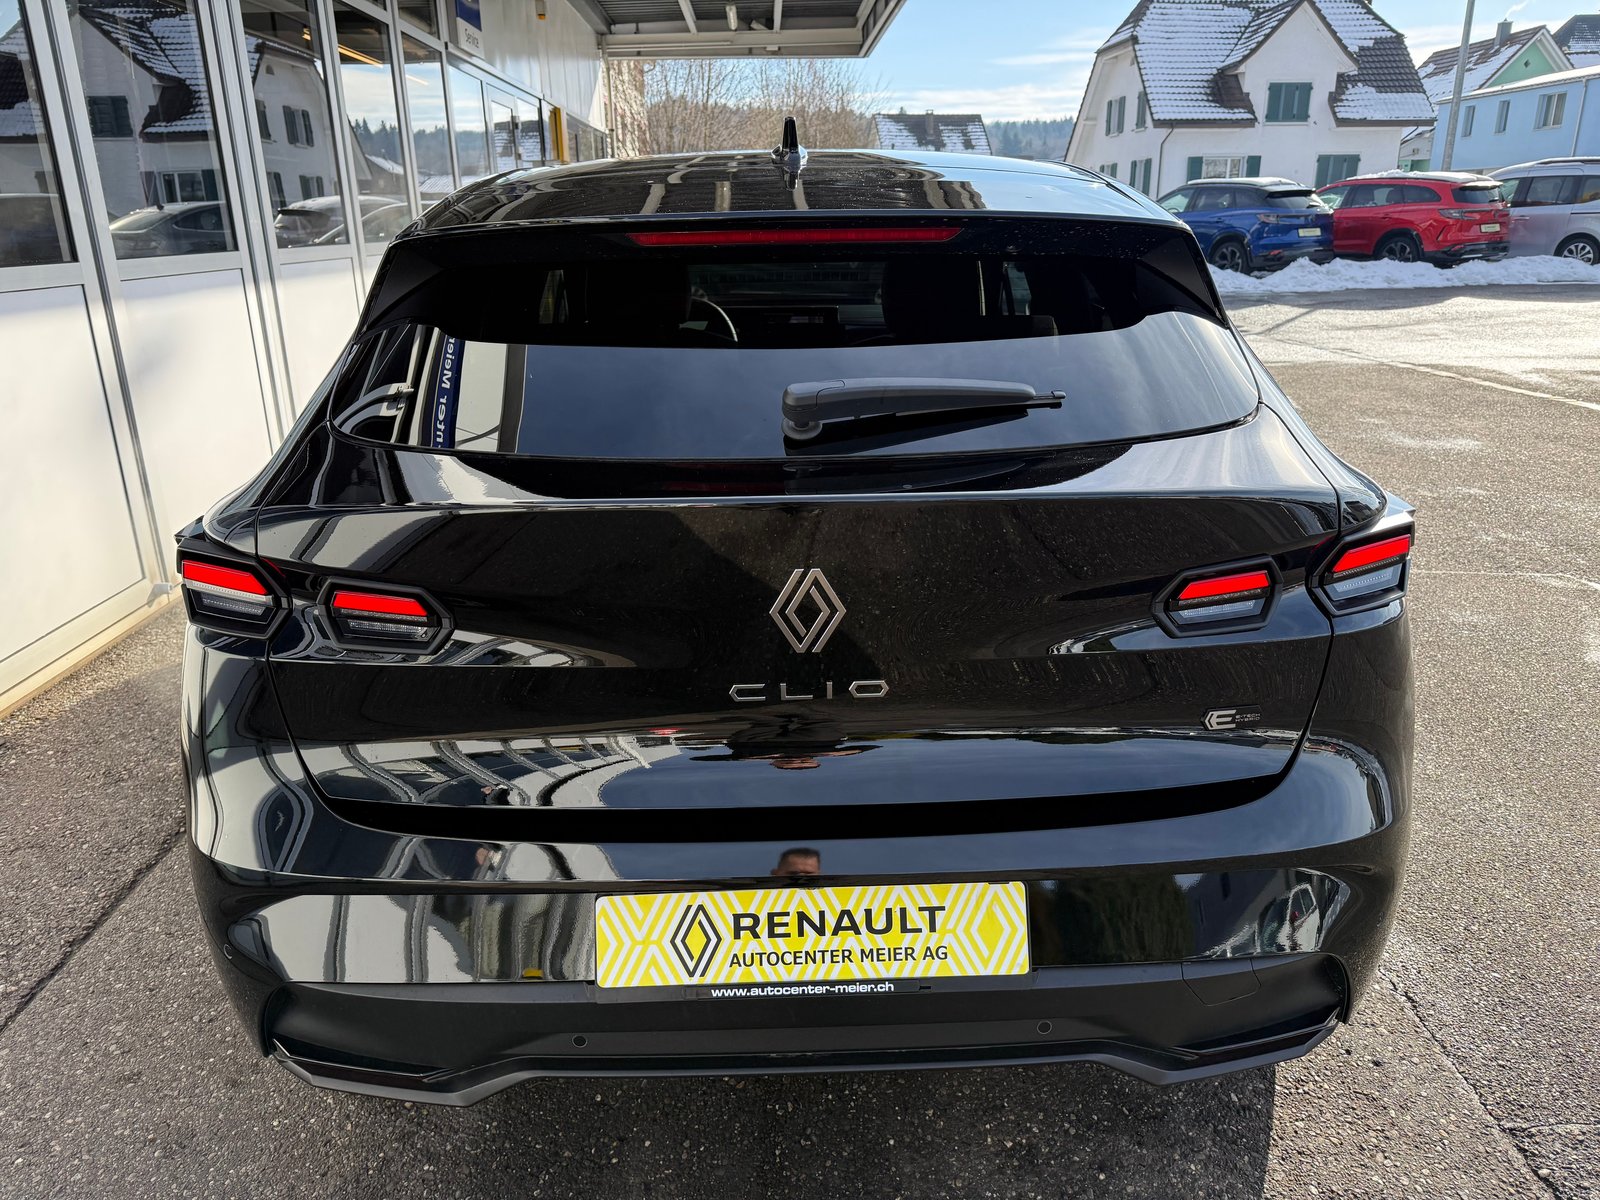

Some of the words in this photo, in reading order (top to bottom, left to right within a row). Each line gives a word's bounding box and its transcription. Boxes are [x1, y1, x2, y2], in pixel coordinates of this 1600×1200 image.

[464, 28, 480, 48] Service
[728, 679, 890, 703] CLIO
[732, 905, 947, 941] RENAULT
[729, 949, 854, 968] AUTOCENTER
[859, 947, 917, 964] MEIER
[922, 945, 949, 962] AG
[711, 981, 895, 998] www.autocenter-meier.ch
